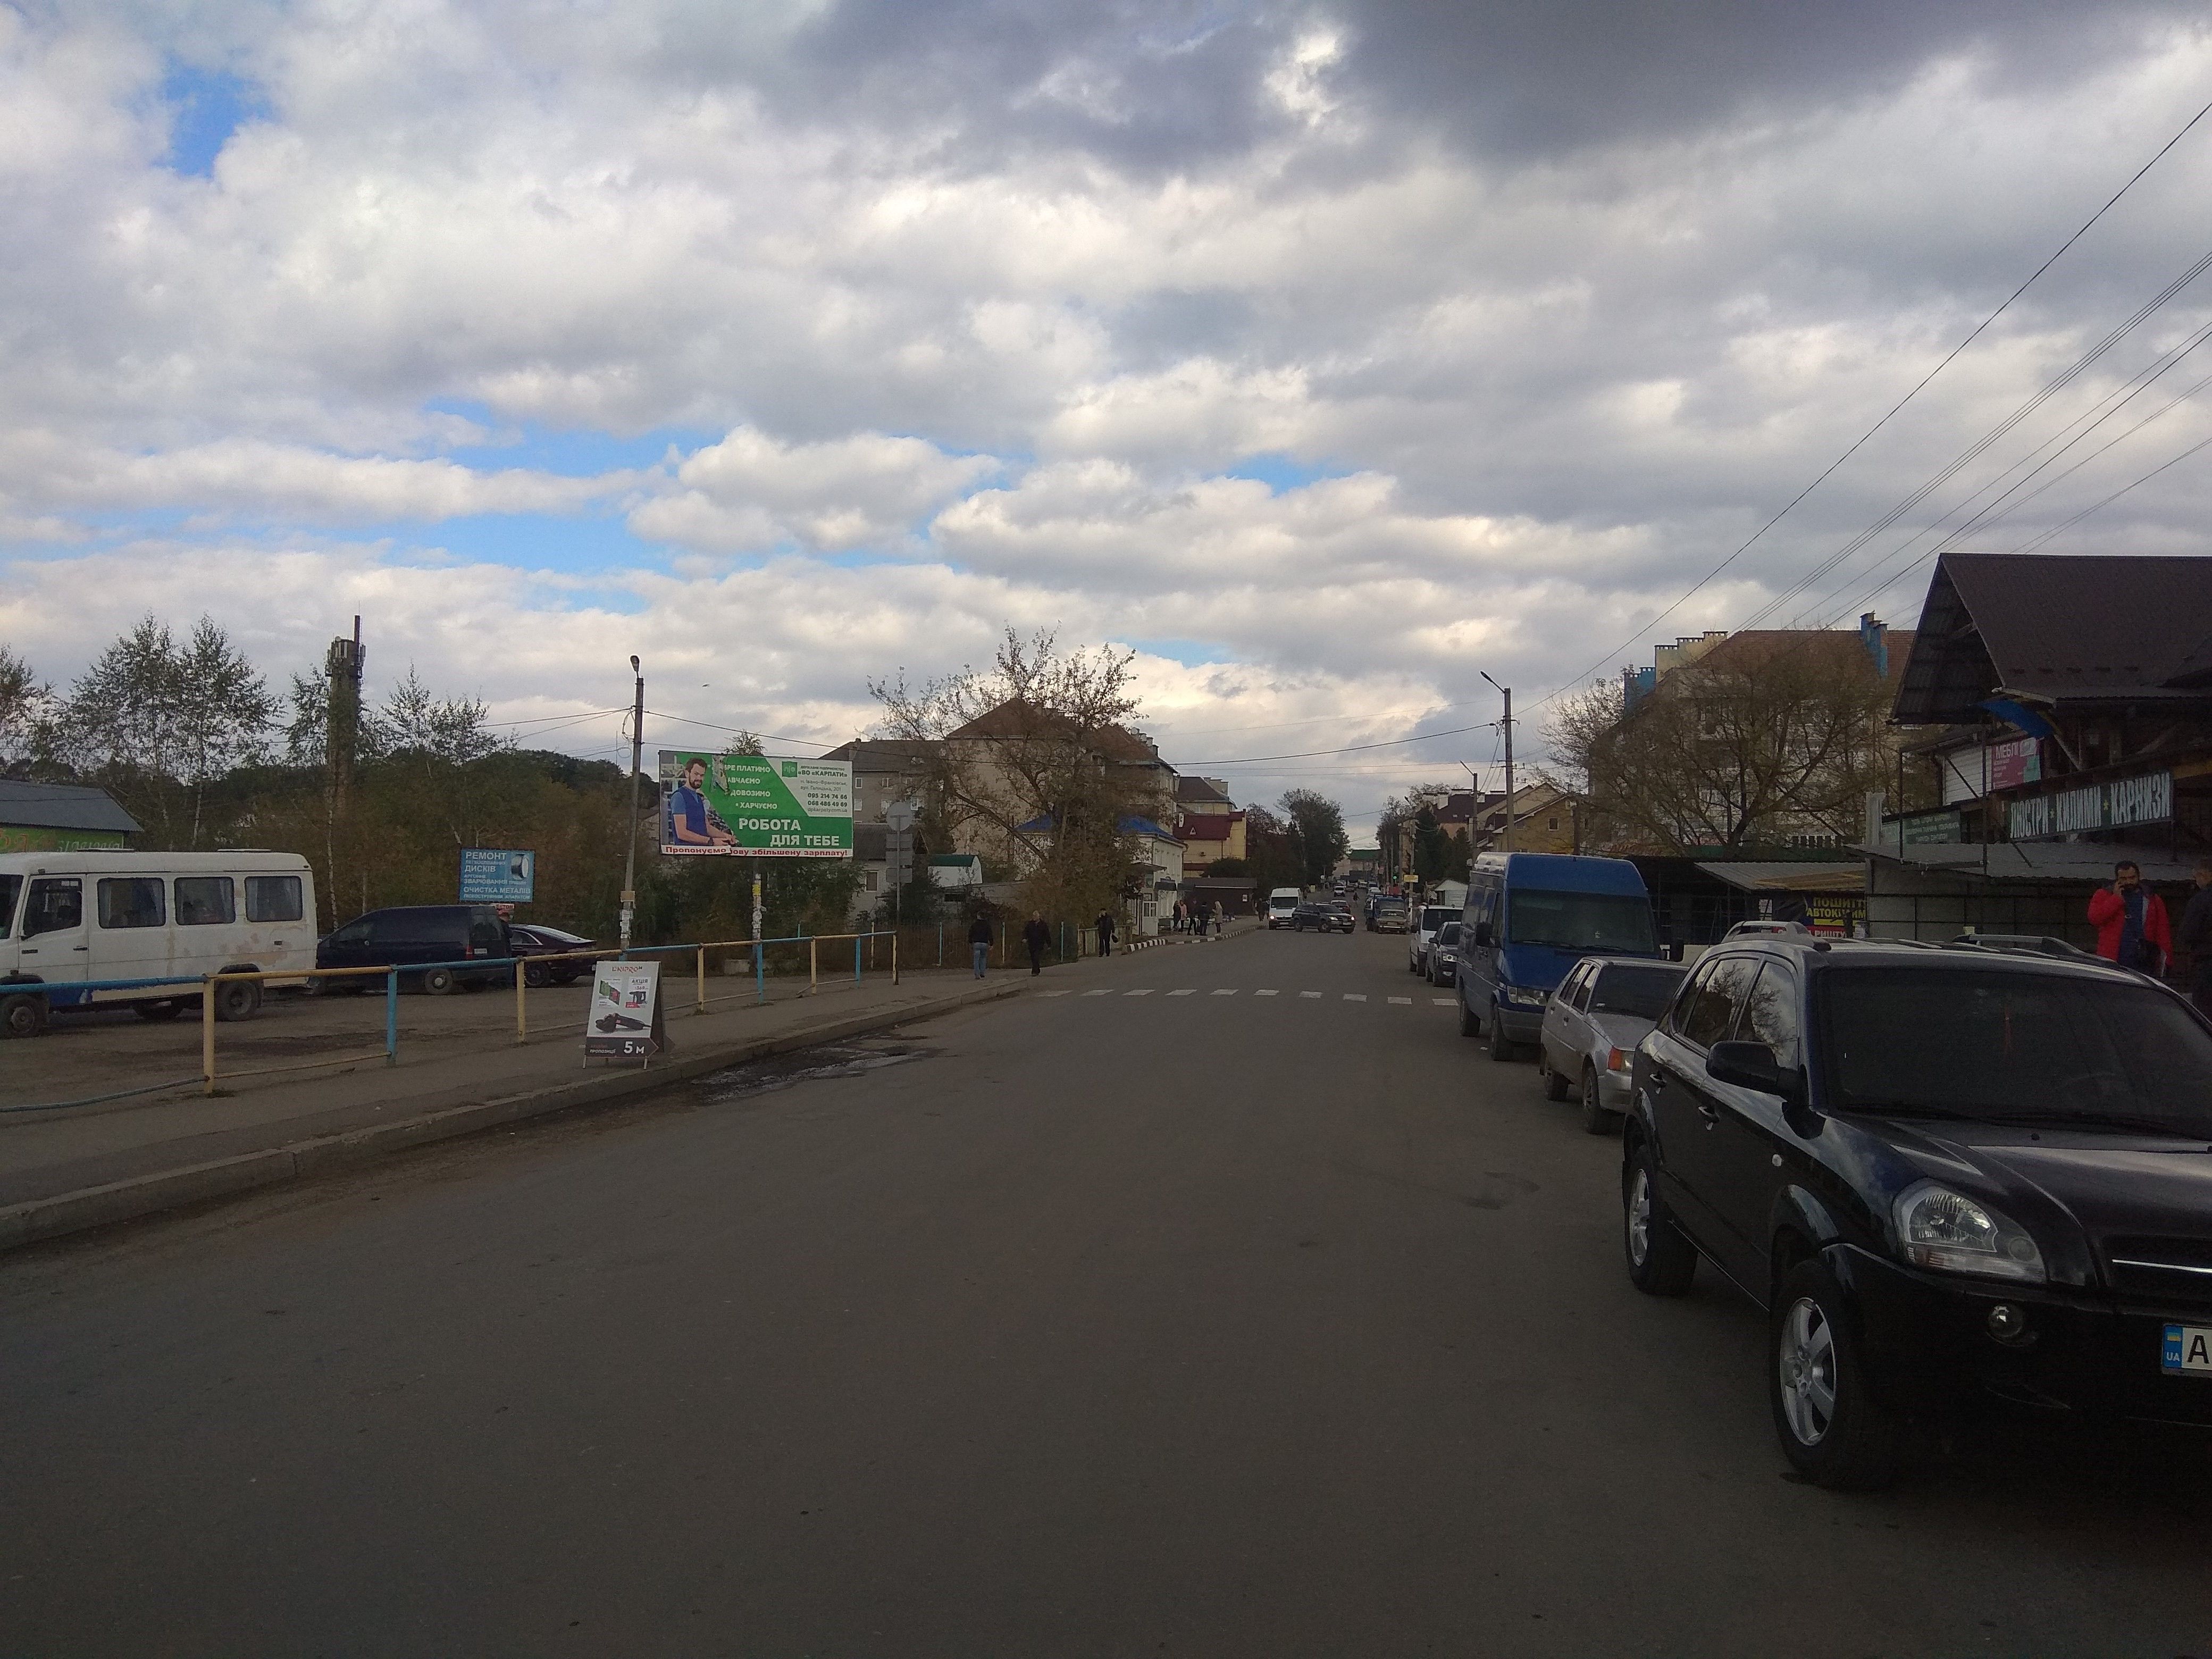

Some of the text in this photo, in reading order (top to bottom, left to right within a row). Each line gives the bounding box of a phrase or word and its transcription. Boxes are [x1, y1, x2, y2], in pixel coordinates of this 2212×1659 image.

[2010, 773, 2170, 839] ЛЮСТРИ КИЛИМИ КАРНИЗИ
[739, 818, 801, 831] РОБОТА
[770, 834, 839, 847] ДЛЯ ТЕБЕ
[623, 1041, 633, 1054] 5
[2187, 1335, 2210, 1364] A
[2166, 1352, 2180, 1362] UA
